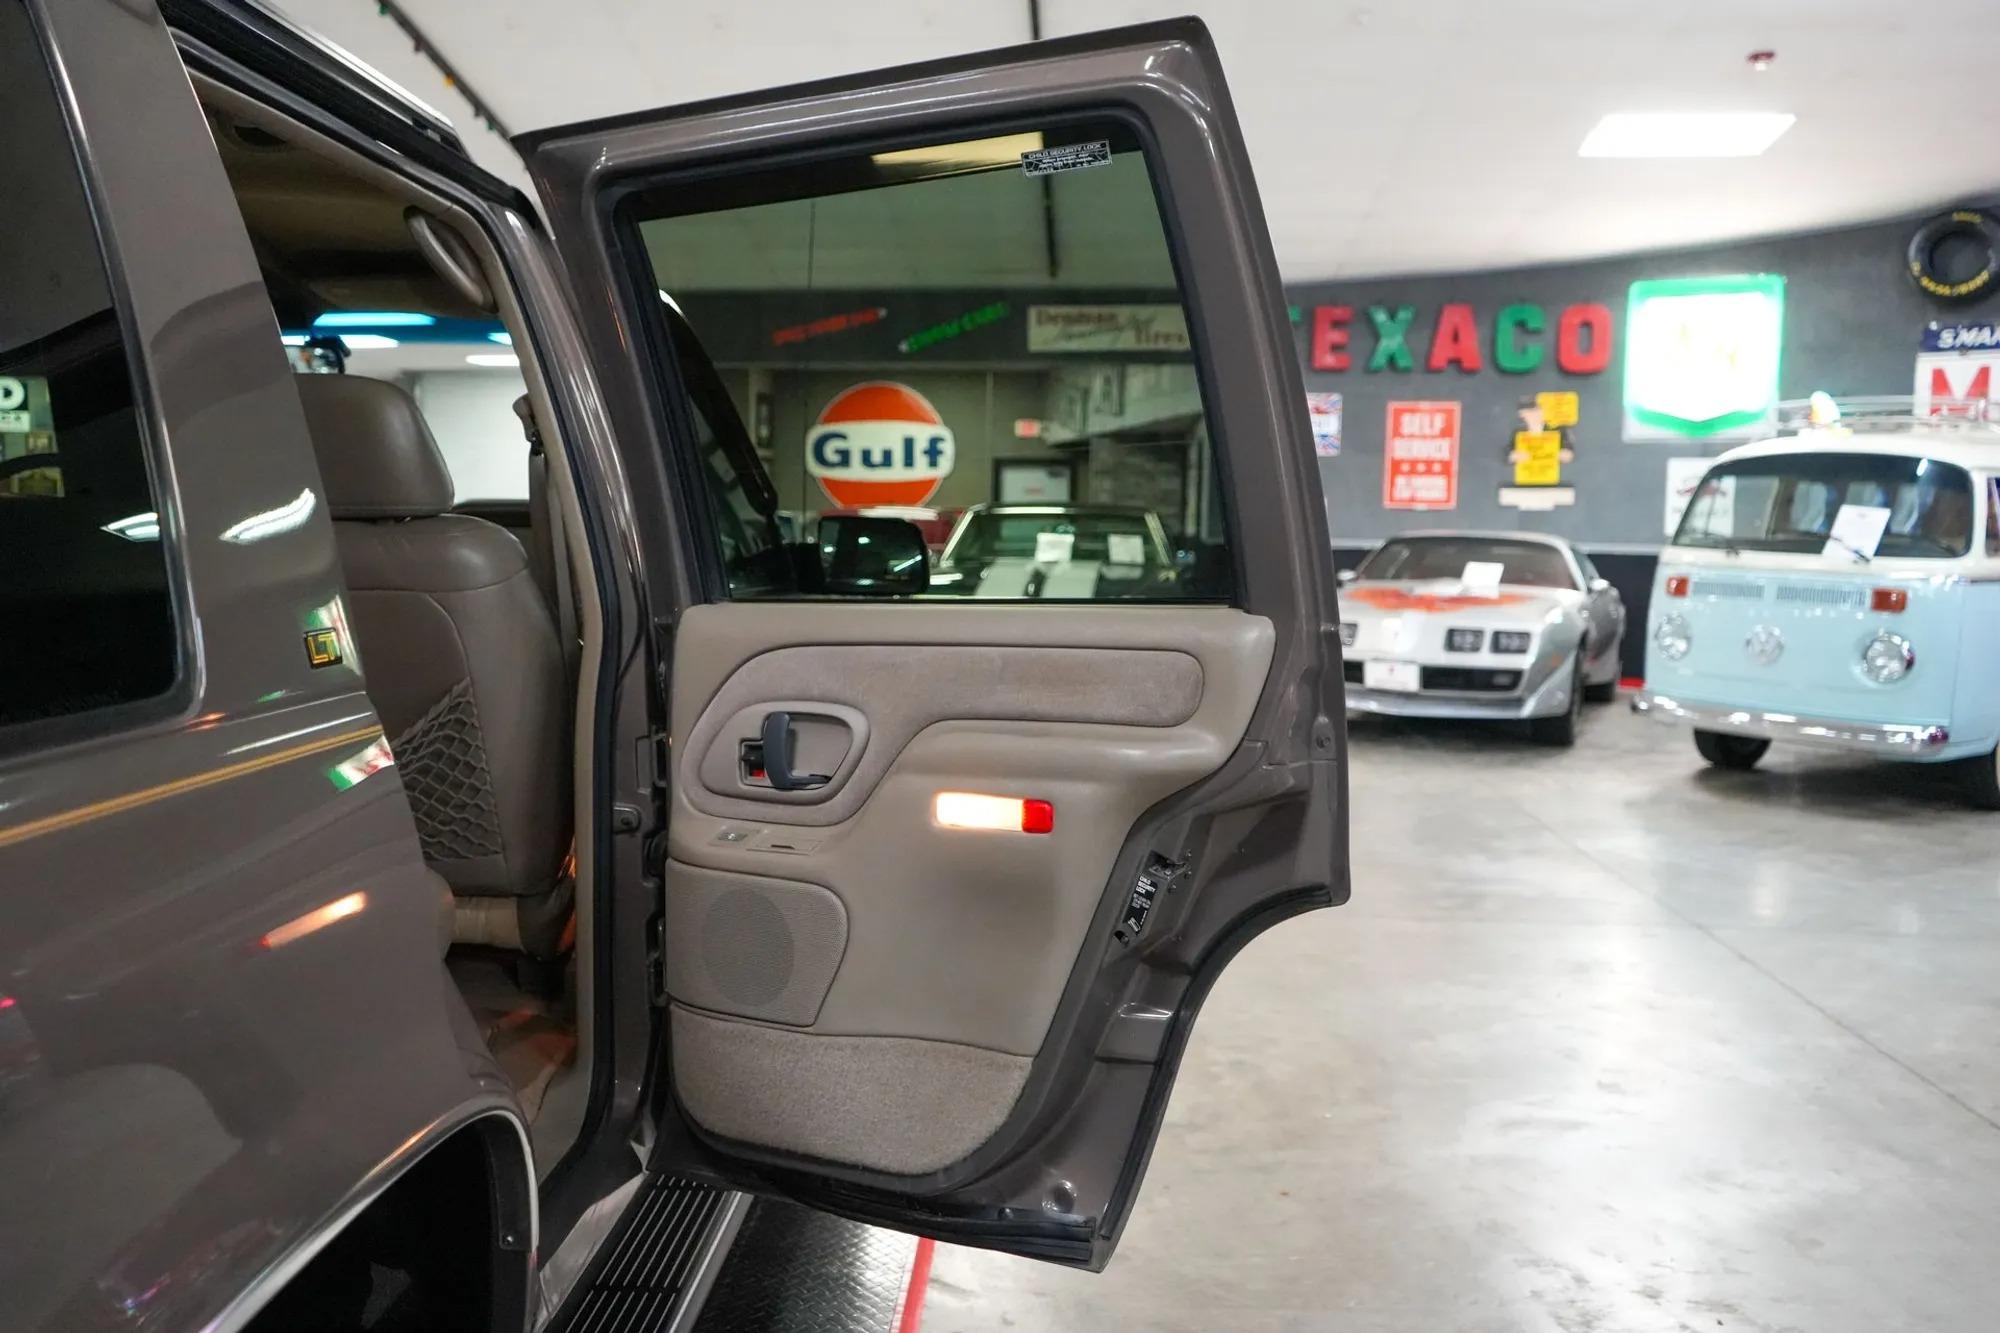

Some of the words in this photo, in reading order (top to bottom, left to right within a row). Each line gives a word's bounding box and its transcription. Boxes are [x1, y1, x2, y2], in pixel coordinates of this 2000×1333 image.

[1287, 303, 1613, 374] EXACO
[1937, 326, 2000, 349] SMA
[813, 432, 946, 469] Gulf
[307, 631, 341, 665] LT
